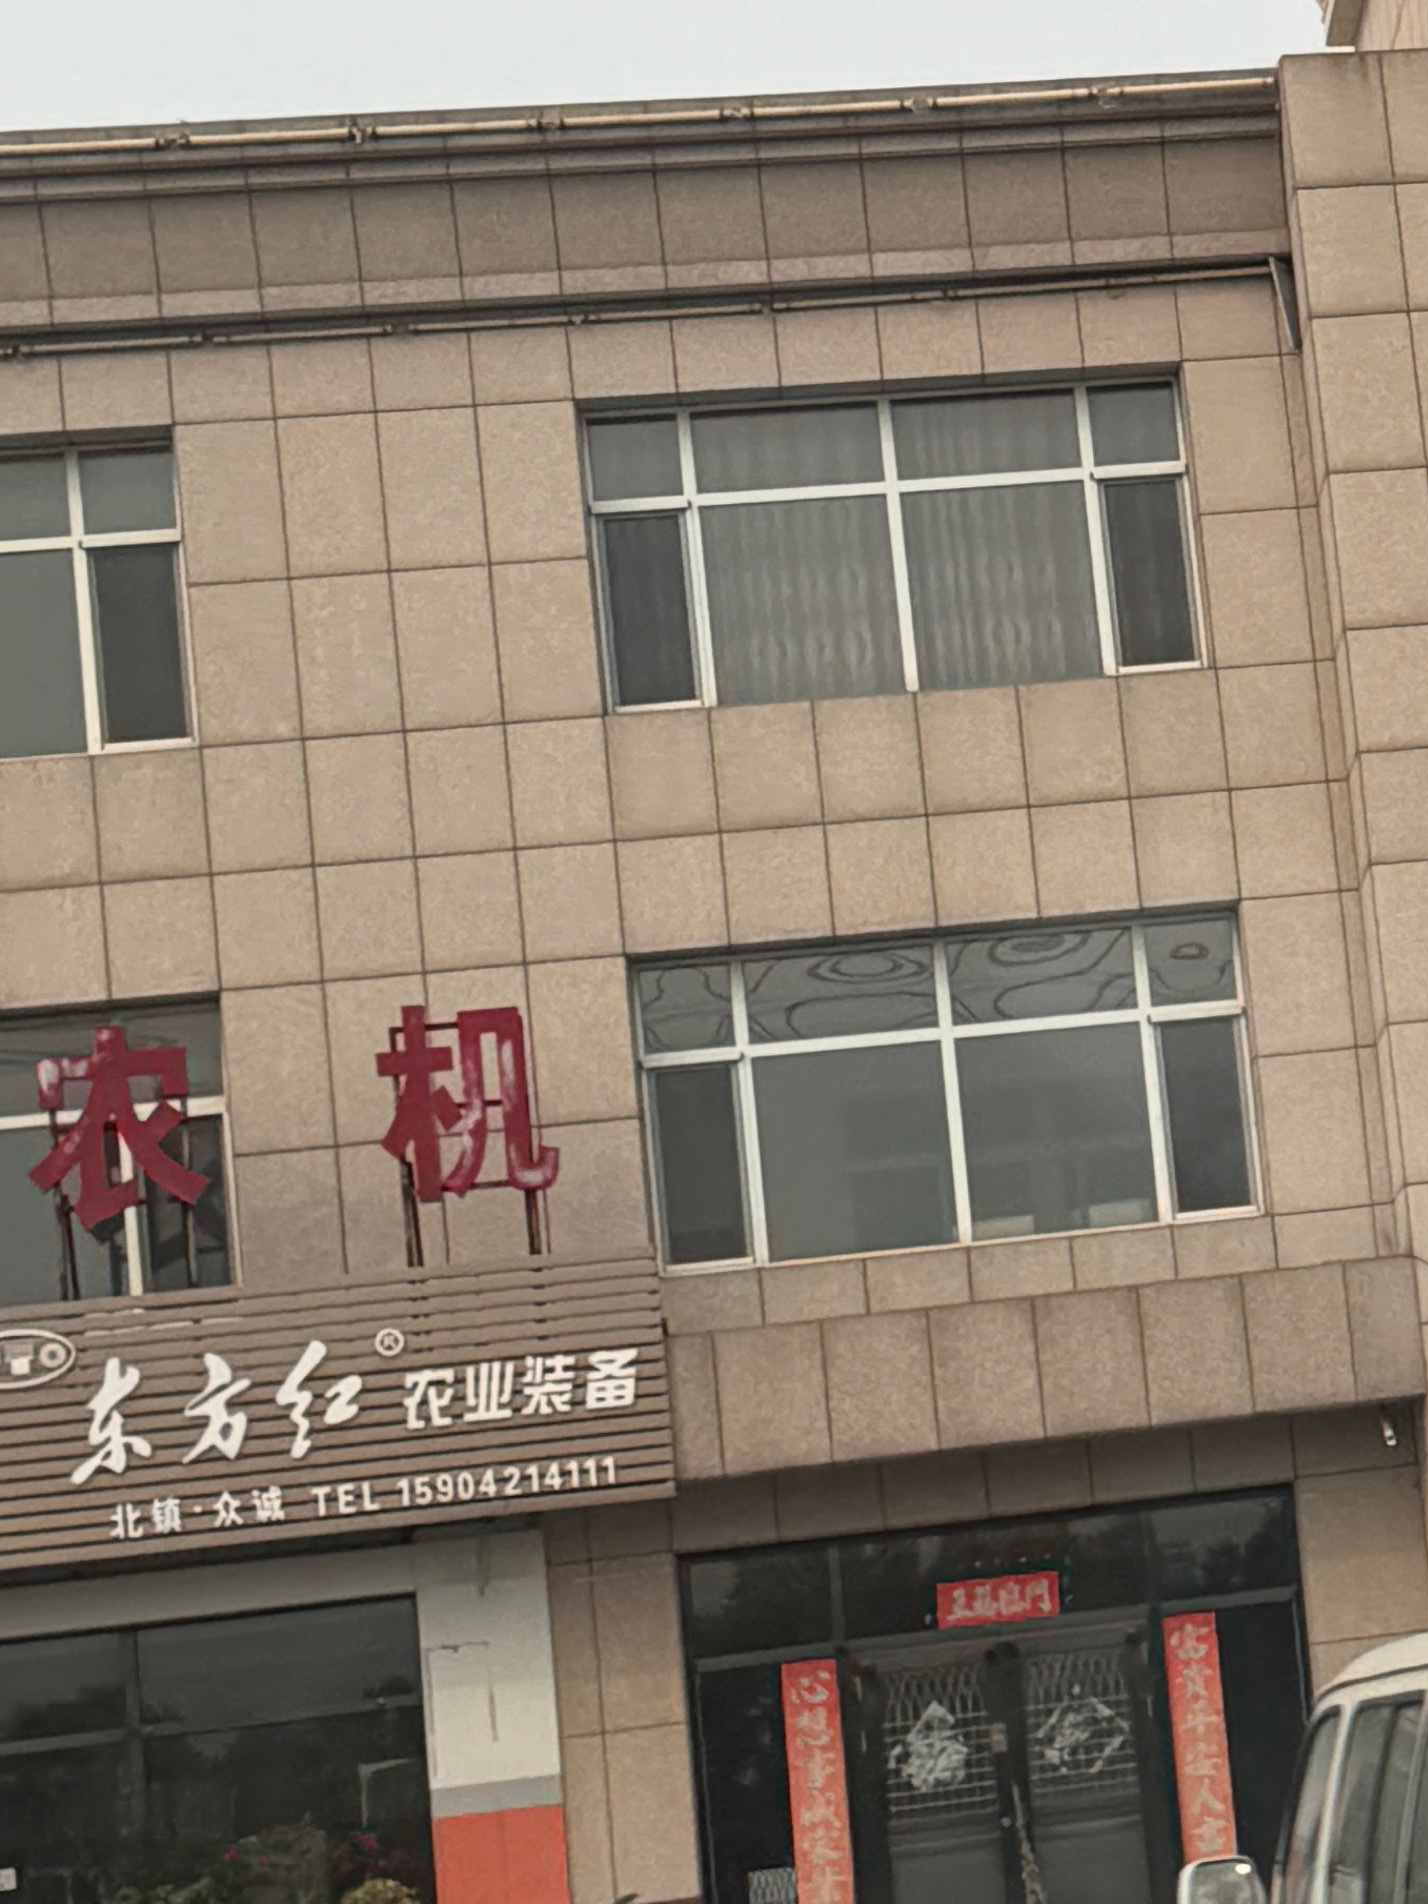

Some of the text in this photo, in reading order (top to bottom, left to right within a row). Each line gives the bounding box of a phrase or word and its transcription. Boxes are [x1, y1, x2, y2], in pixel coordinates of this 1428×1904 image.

[28, 1005, 560, 1225] 农机
[70, 1339, 640, 1485] 东方红 农业装备
[310, 1481, 381, 1517] TEL
[396, 1455, 618, 1506] 15904214111
